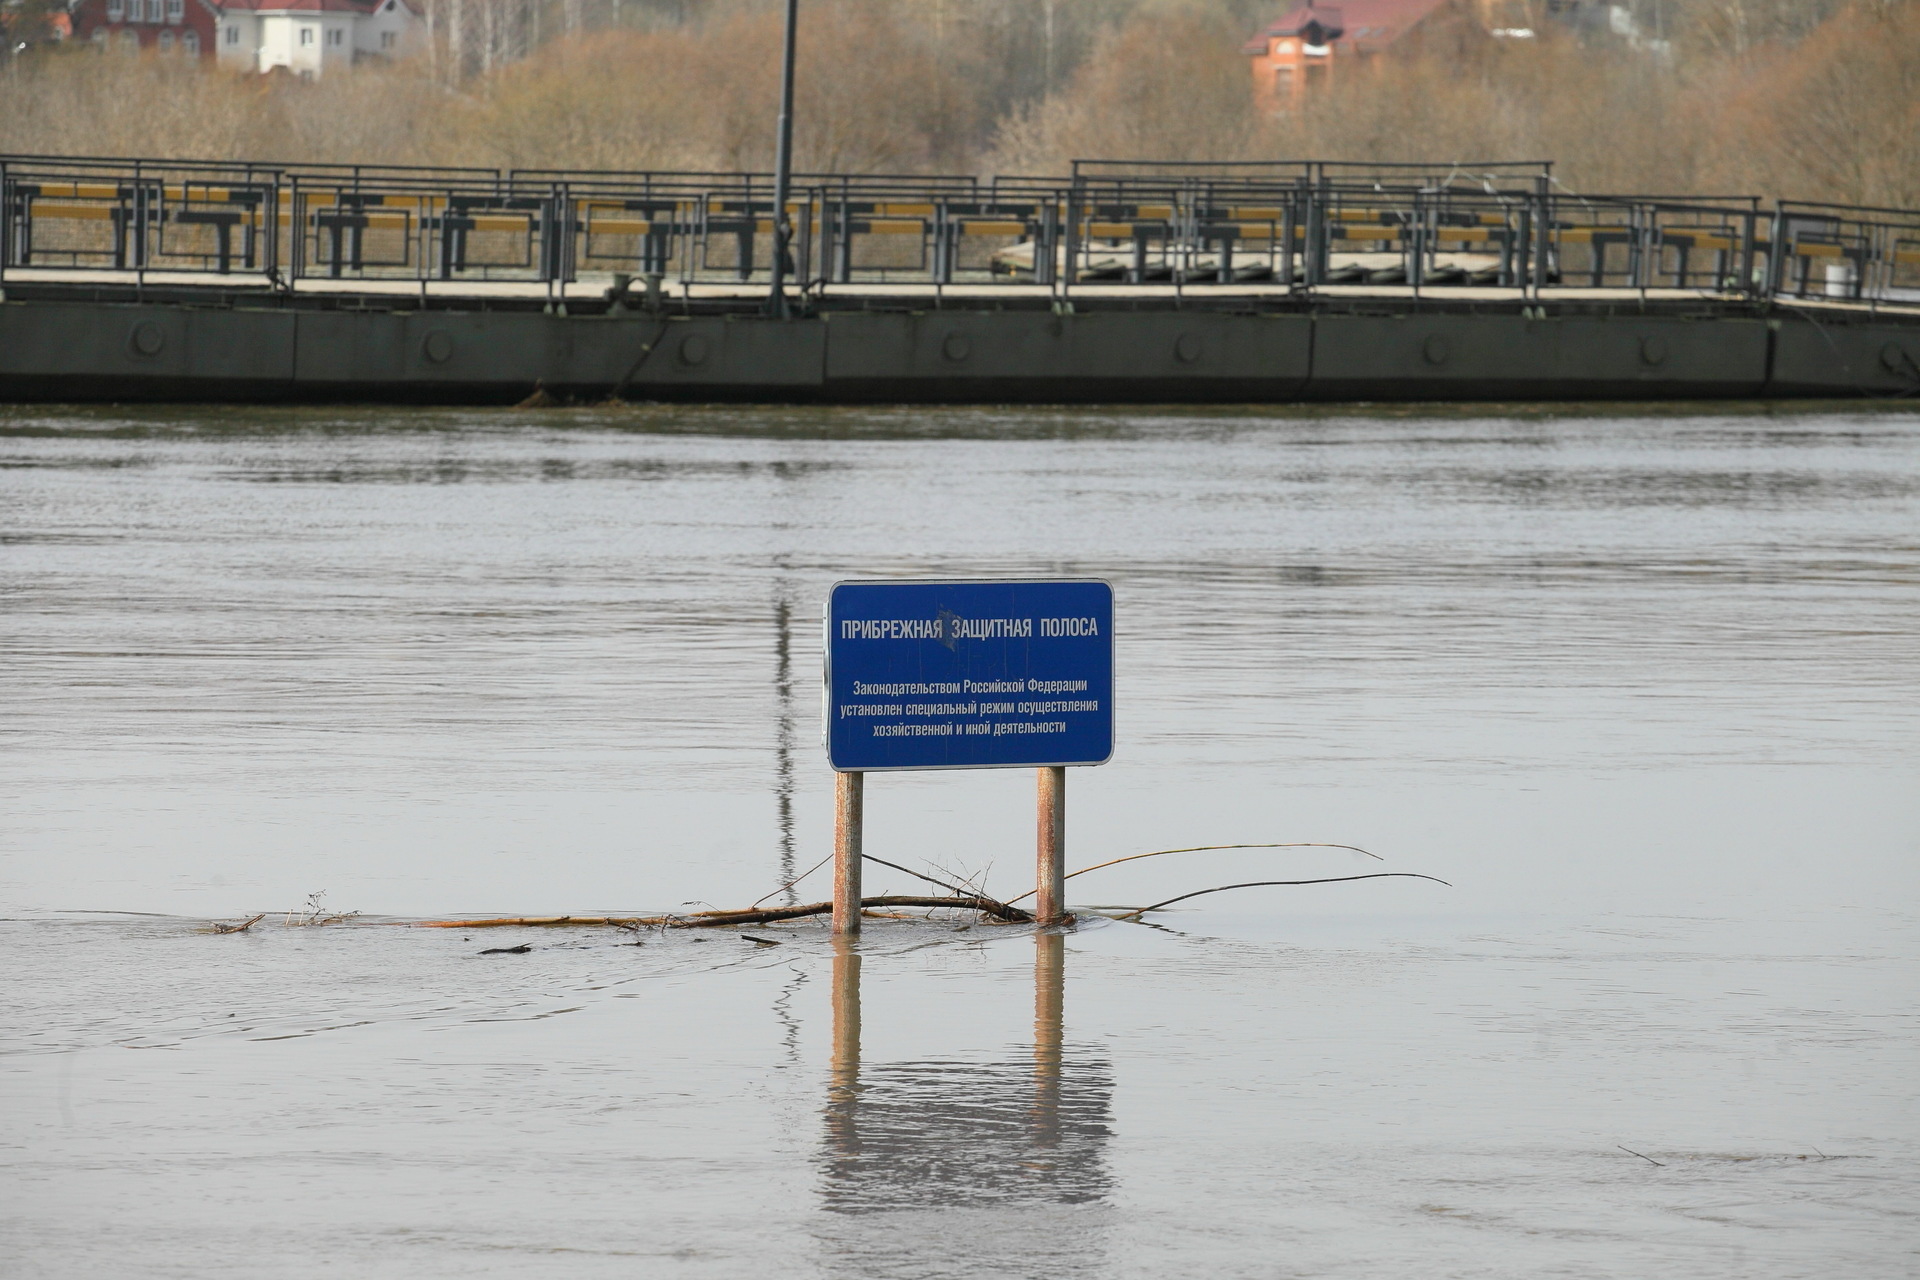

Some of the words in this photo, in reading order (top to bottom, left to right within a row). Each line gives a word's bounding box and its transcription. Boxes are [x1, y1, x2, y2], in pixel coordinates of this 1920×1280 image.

[841, 619, 943, 639] ПРИБРЕЖНАЯ
[951, 618, 1032, 641] ЗАЩИТНАЯ
[1041, 618, 1098, 637] ПОЛОСА
[853, 681, 960, 697] Законодательством
[963, 679, 1024, 694] Российской
[1028, 678, 1087, 694] Федерации
[840, 703, 902, 719] установлен
[906, 700, 977, 716] специальный
[980, 702, 1014, 717] режим
[1018, 700, 1098, 715] осуществления
[873, 722, 953, 737] хозяйственной
[956, 724, 962, 735] и
[966, 721, 990, 735] иной
[993, 721, 1066, 736] деятельности
